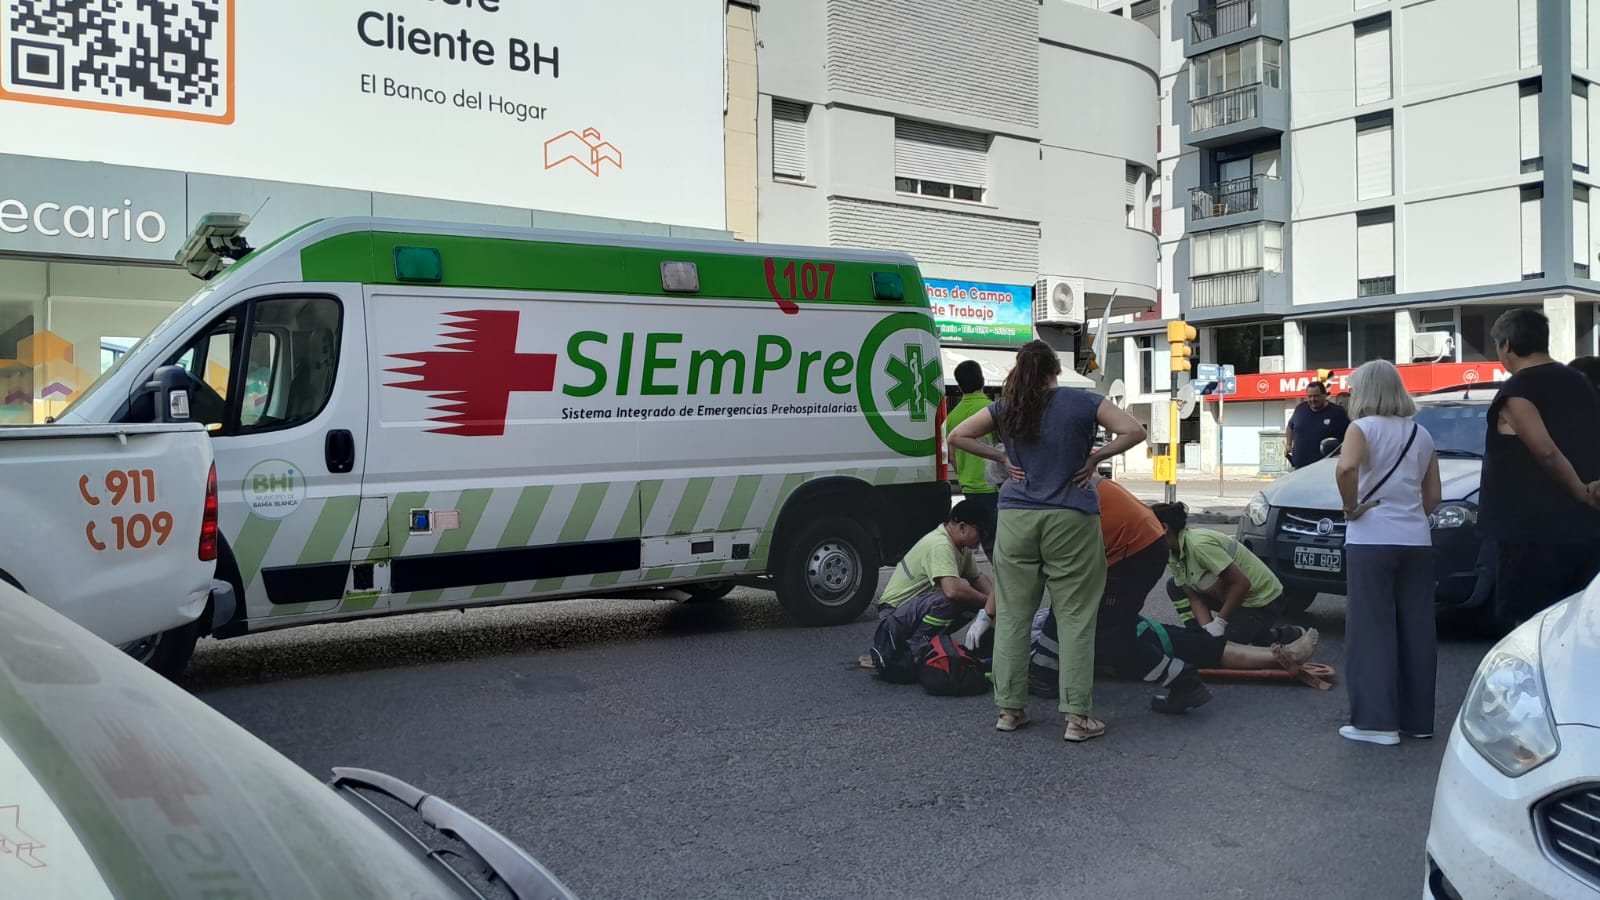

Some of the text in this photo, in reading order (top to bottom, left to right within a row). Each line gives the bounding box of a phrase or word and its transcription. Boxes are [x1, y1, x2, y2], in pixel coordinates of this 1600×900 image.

[357, 11, 559, 78] Cliente BH
[361, 74, 547, 122] El Banco del Hogar
[0, 198, 167, 244] ecario
[784, 261, 836, 300] 107
[951, 286, 966, 299] de
[969, 288, 1013, 304] Campo
[931, 302, 994, 321] de Trabajo
[562, 330, 854, 398] SIEmPre
[561, 402, 858, 420] Sistema Integrado de Emergencias Prehospitalarias
[105, 469, 155, 505] 911
[111, 511, 173, 550] 109
[1320, 554, 1340, 568] 802
